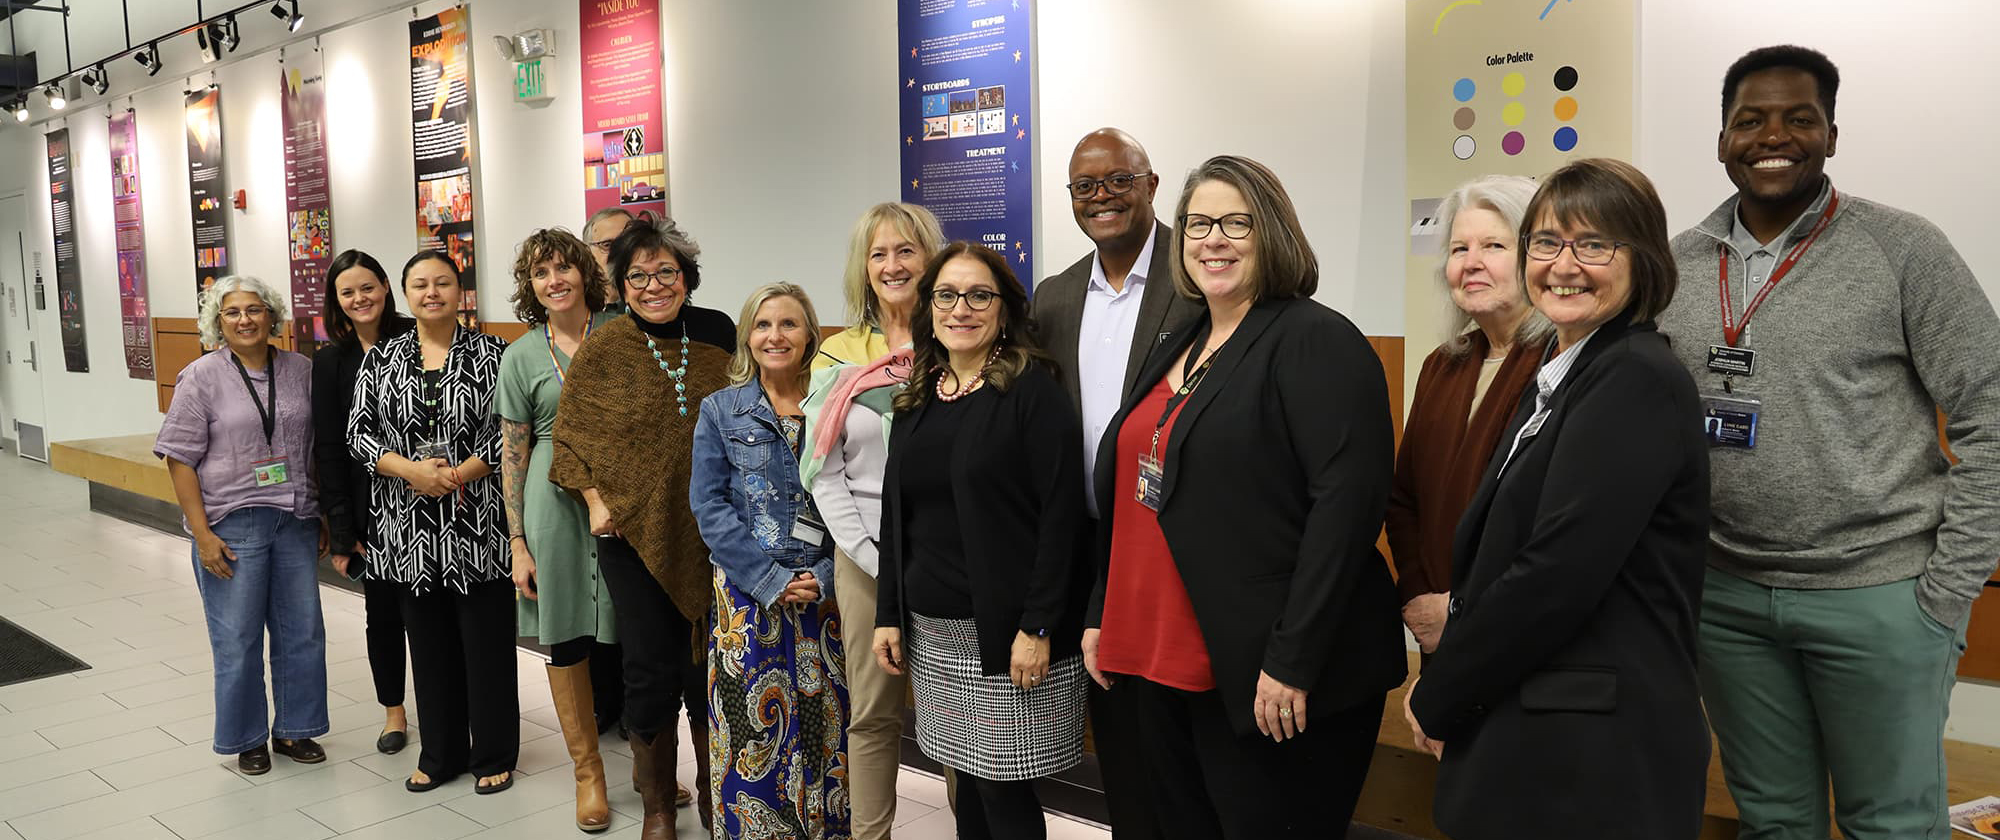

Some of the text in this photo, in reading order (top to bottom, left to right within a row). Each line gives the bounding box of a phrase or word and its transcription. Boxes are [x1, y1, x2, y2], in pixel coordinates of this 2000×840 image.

[1486, 51, 1534, 66] Color Palette
[517, 60, 541, 98] EXIT
[966, 146, 1006, 158] TREATMENT
[983, 233, 1006, 242] COLOR
